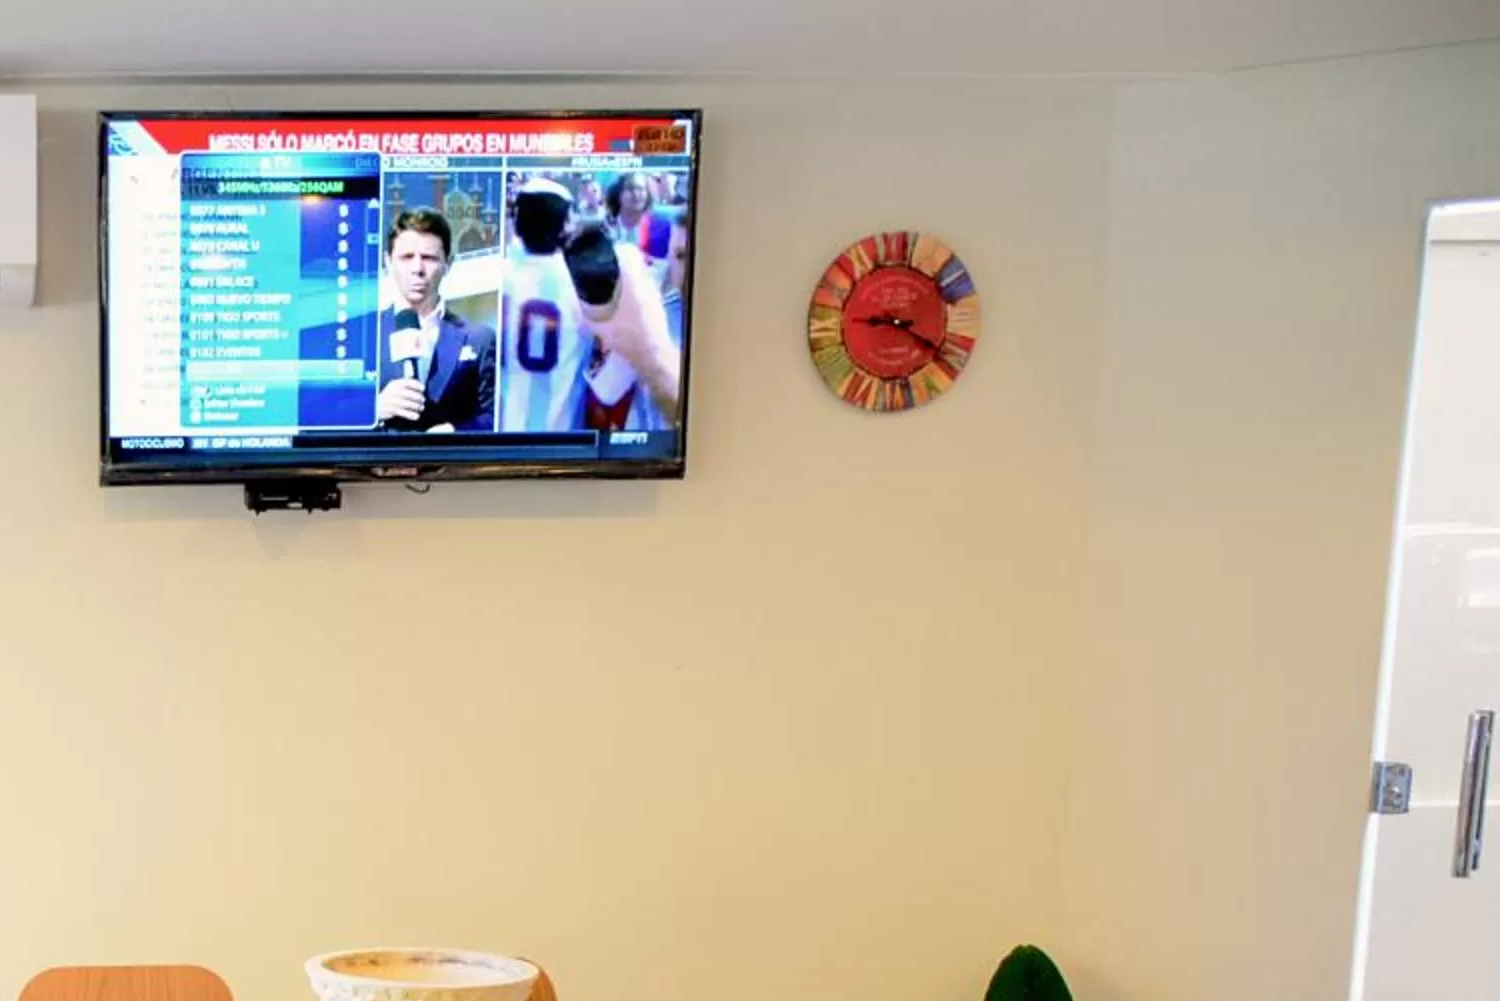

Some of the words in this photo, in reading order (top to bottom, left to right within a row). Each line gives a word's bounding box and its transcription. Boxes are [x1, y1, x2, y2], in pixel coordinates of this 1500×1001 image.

[209, 133, 255, 150] MESSI
[257, 129, 299, 150] SÓLO
[301, 129, 358, 150] MARCÓ
[359, 133, 380, 150] EN
[382, 133, 419, 152] FASE
[422, 133, 483, 152] GRUPOS
[486, 133, 507, 152] EN
